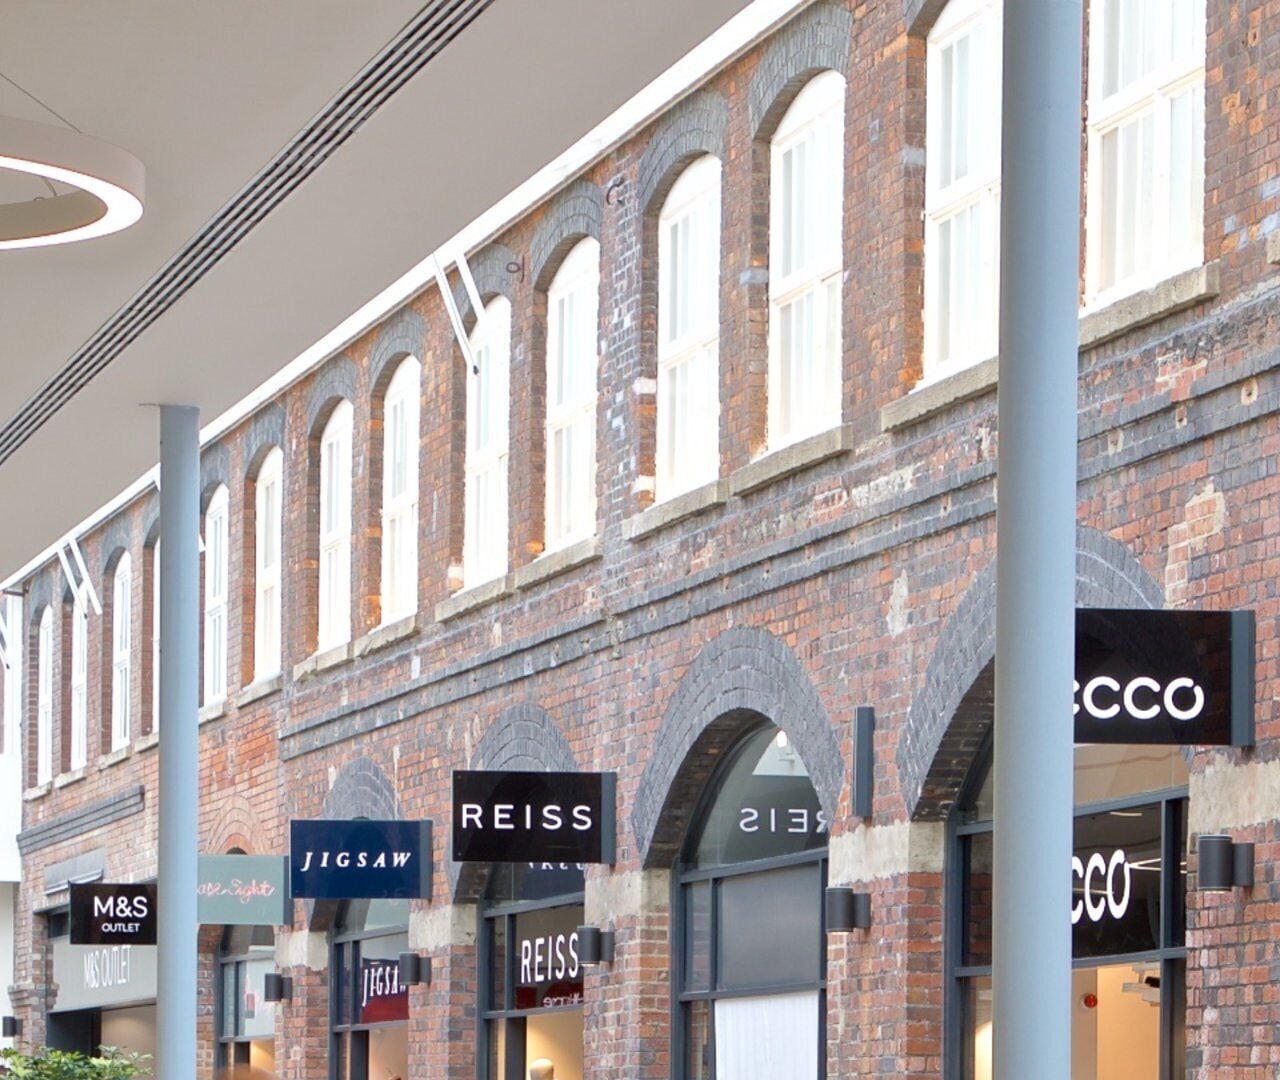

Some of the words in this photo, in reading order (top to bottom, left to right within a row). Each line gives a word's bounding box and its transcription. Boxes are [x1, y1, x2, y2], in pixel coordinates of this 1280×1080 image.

[1073, 676, 1205, 720] cco
[462, 804, 593, 830] REISS
[300, 852, 411, 872] JIGSAW
[93, 896, 148, 918] M&S
[1072, 849, 1131, 925] cco
[101, 922, 140, 933] OUTLET
[102, 945, 132, 987] OUTLET
[520, 932, 579, 984] REISS
[362, 964, 405, 1007] JIGSA
